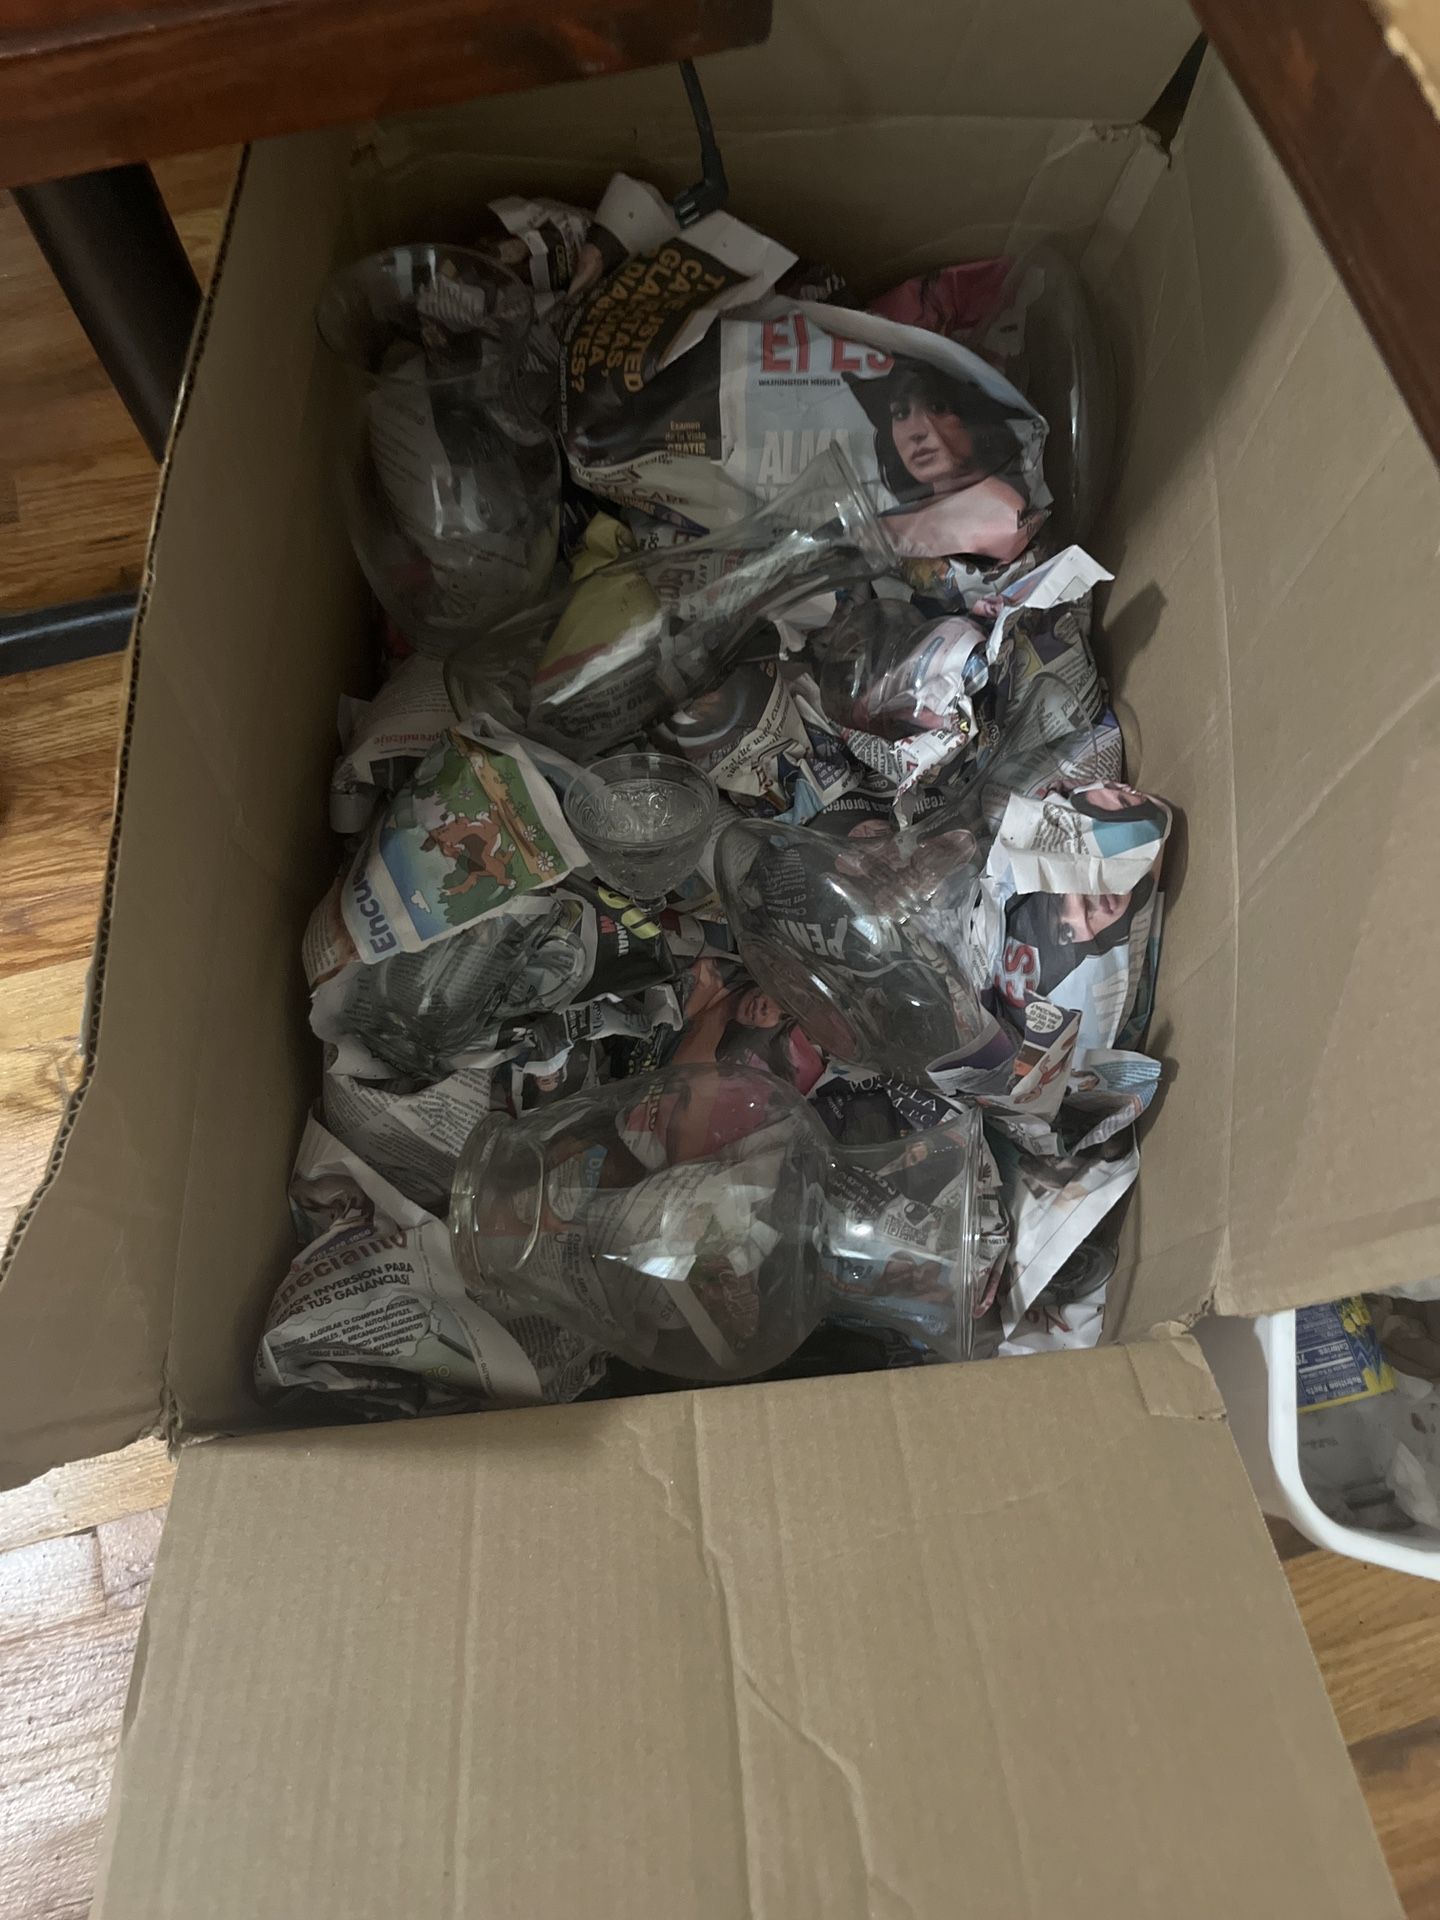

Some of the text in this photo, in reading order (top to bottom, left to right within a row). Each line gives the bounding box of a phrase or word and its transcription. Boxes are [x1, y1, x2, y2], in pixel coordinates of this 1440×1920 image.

[668, 442, 706, 455] GRATIS
[851, 1075, 938, 1112] POELA
[313, 1265, 382, 1297] INVERSION
[384, 1262, 415, 1274] PARA
[307, 1296, 332, 1310] TUS
[1327, 1377, 1362, 1392] Nutrition
